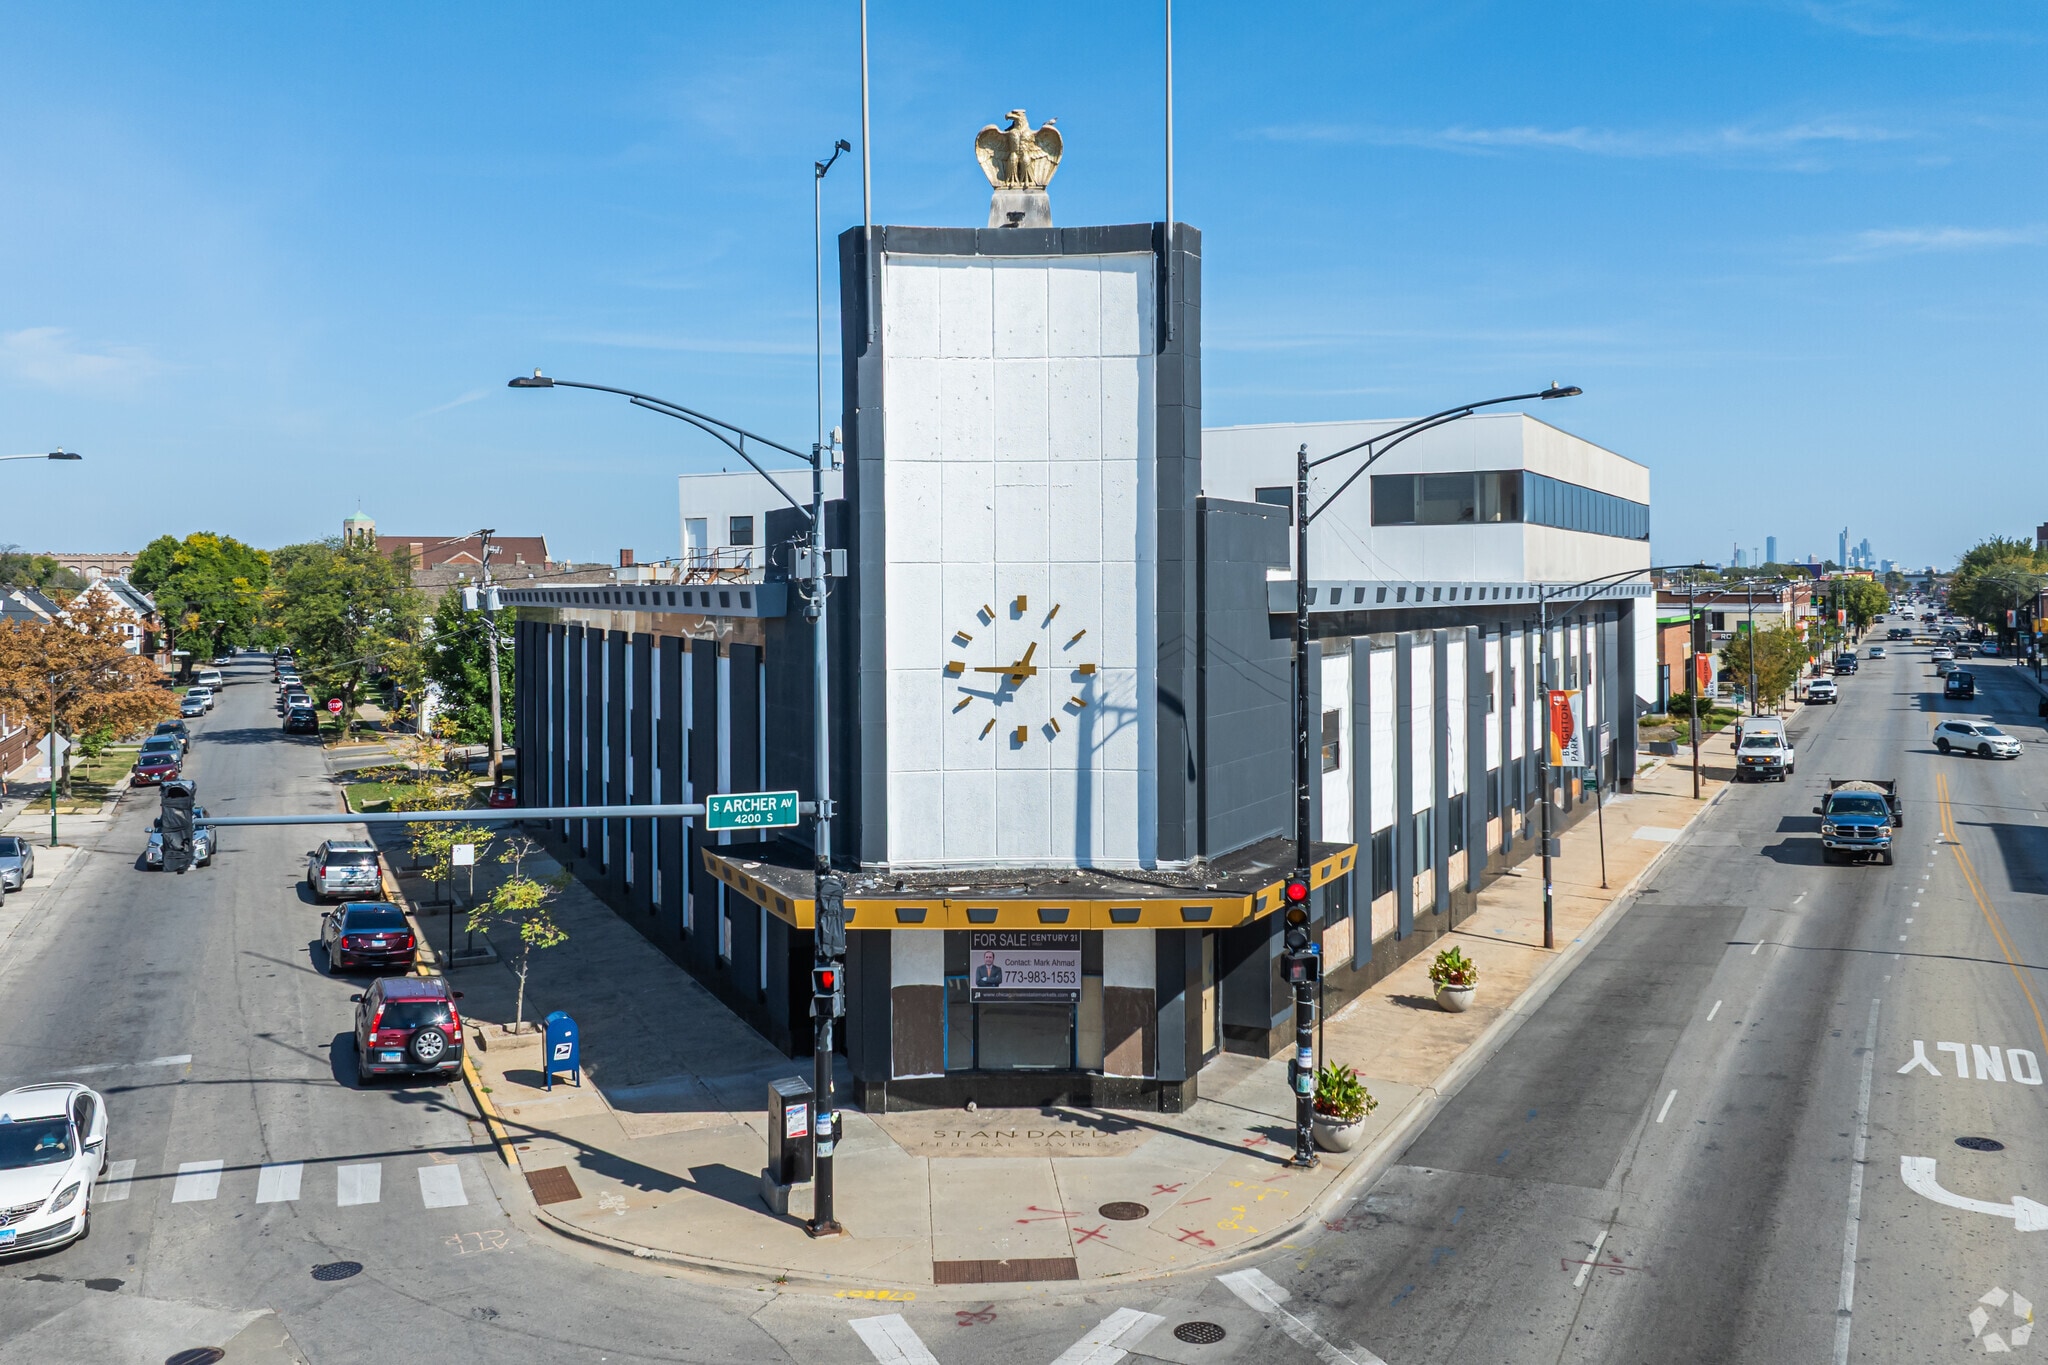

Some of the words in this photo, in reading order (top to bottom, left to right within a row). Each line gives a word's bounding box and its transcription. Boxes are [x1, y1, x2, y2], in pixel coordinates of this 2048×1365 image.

[1562, 704, 1570, 757] BRIGHTON
[1570, 736, 1579, 762] PARK
[713, 802, 719, 812] S
[723, 798, 777, 813] ARCHER
[780, 798, 793, 808] AV
[734, 813, 761, 824] 4200
[767, 813, 774, 822] S
[974, 933, 997, 946] FOR
[1000, 933, 1027, 946] SALE
[1030, 934, 1069, 942] CENTURY
[1070, 934, 1078, 942] 21
[1004, 958, 1031, 967] Contact:
[1033, 958, 1050, 966] Mark
[1051, 958, 1075, 967] Ahmad
[1004, 971, 1076, 984] 773-983-1553
[1897, 1040, 2043, 1086] ONLY
[933, 1129, 1109, 1139] STANDARD
